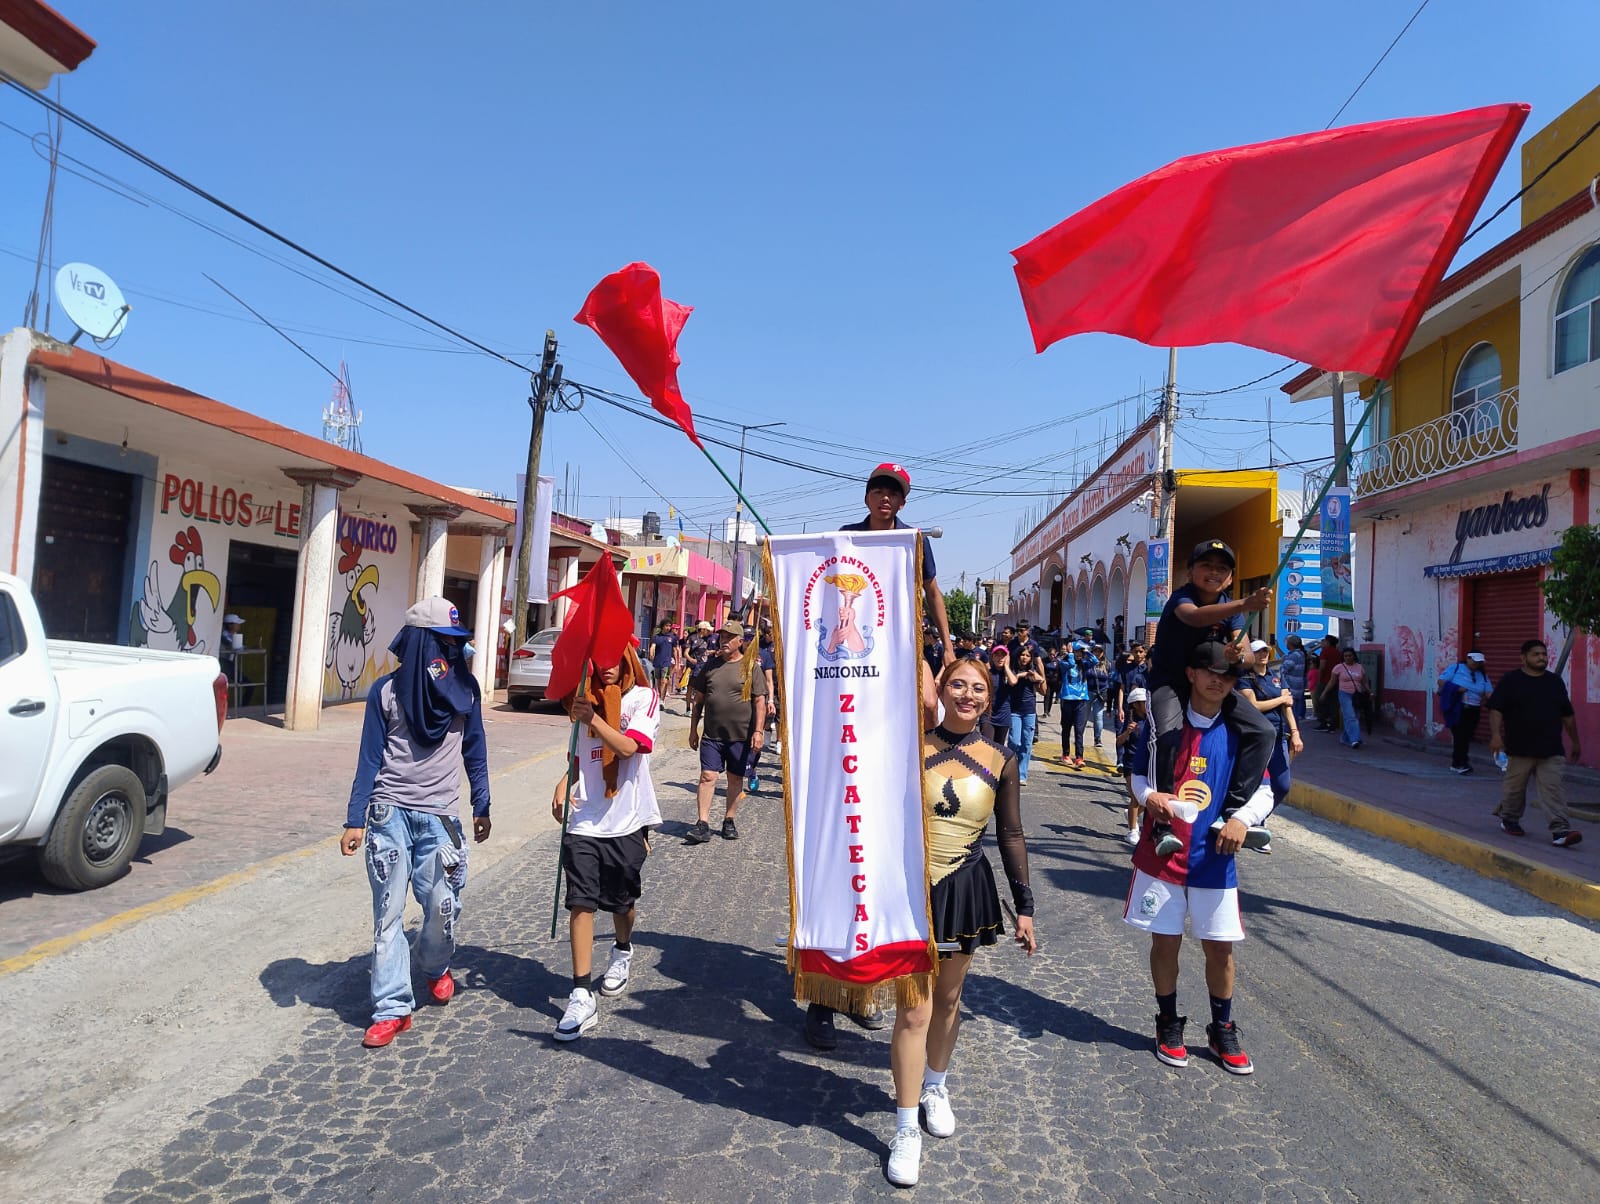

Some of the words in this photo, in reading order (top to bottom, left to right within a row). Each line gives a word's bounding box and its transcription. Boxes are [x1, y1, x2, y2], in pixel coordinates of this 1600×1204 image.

[161, 473, 253, 527] POLLOS
[274, 499, 301, 538] LE
[1107, 448, 1145, 498] Campesina
[803, 556, 838, 631] MOVIMIENTO
[840, 555, 885, 628] ANTORCHISTA
[813, 665, 880, 680] NACIONAL
[839, 693, 869, 952] ZACATECAS
